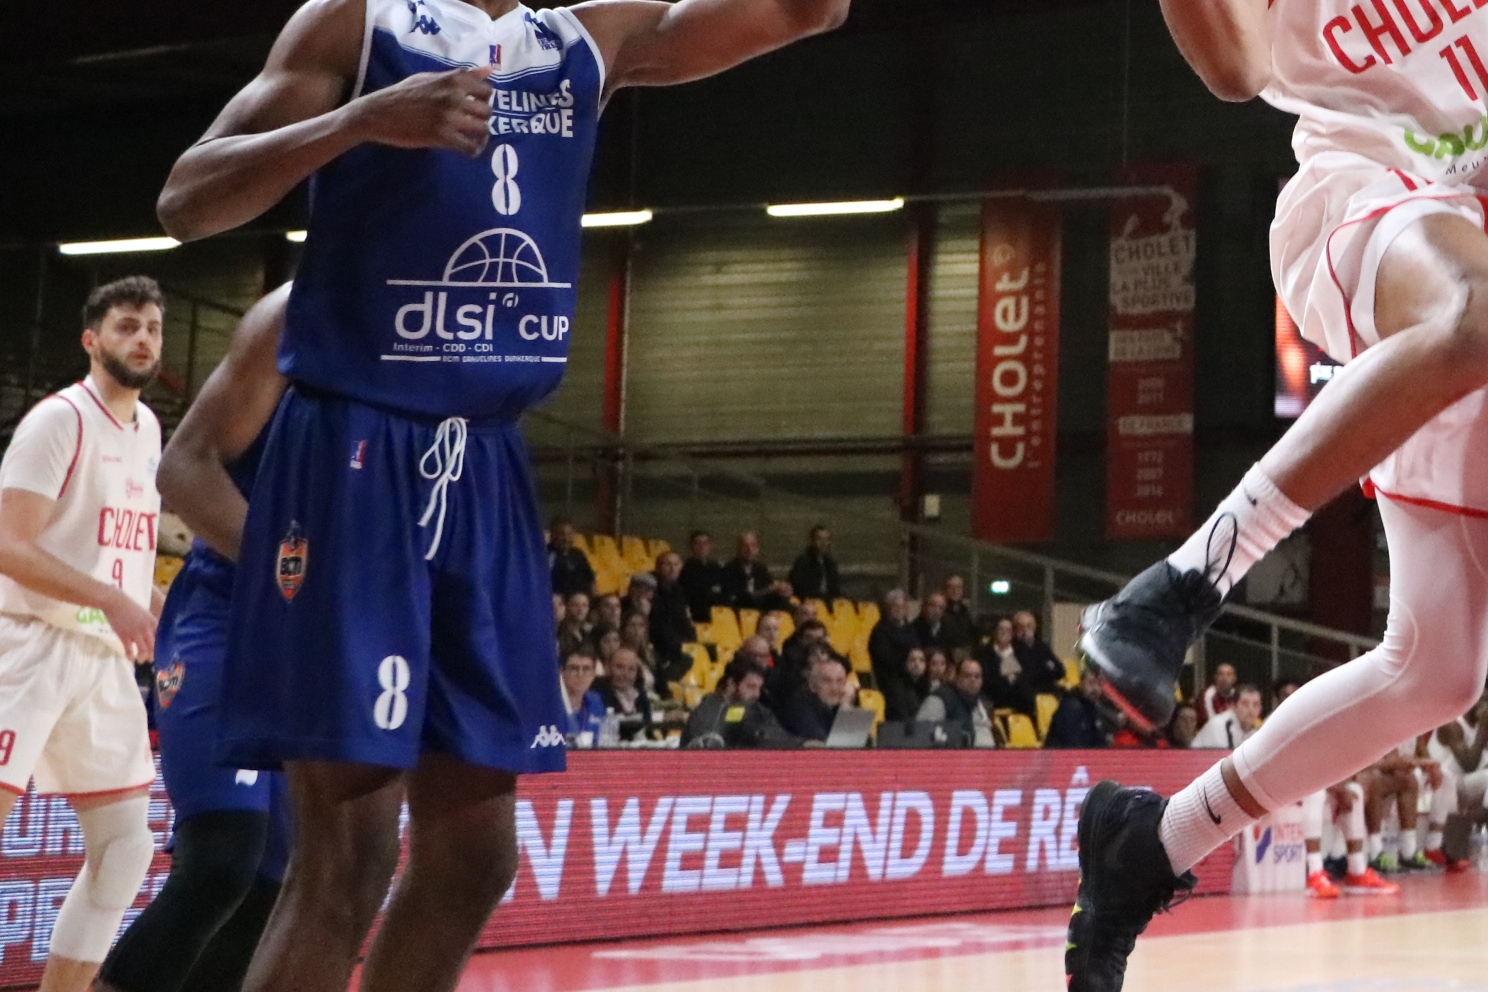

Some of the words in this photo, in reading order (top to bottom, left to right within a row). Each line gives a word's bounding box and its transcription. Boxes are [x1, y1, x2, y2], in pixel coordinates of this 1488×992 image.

[488, 109, 574, 138] KERQUE
[491, 143, 522, 216] 8
[394, 291, 497, 340] dlsi
[518, 314, 569, 341] CUP
[393, 342, 433, 352] Interim
[442, 343, 466, 353] CDD
[474, 343, 493, 352] CDI
[97, 506, 158, 552] CHOLET
[112, 558, 123, 590] 9
[373, 655, 411, 731] 8
[502, 798, 574, 902] N
[590, 790, 935, 898] WEEK-END
[942, 788, 1023, 877] DE
[1026, 765, 1089, 873] RÊ
